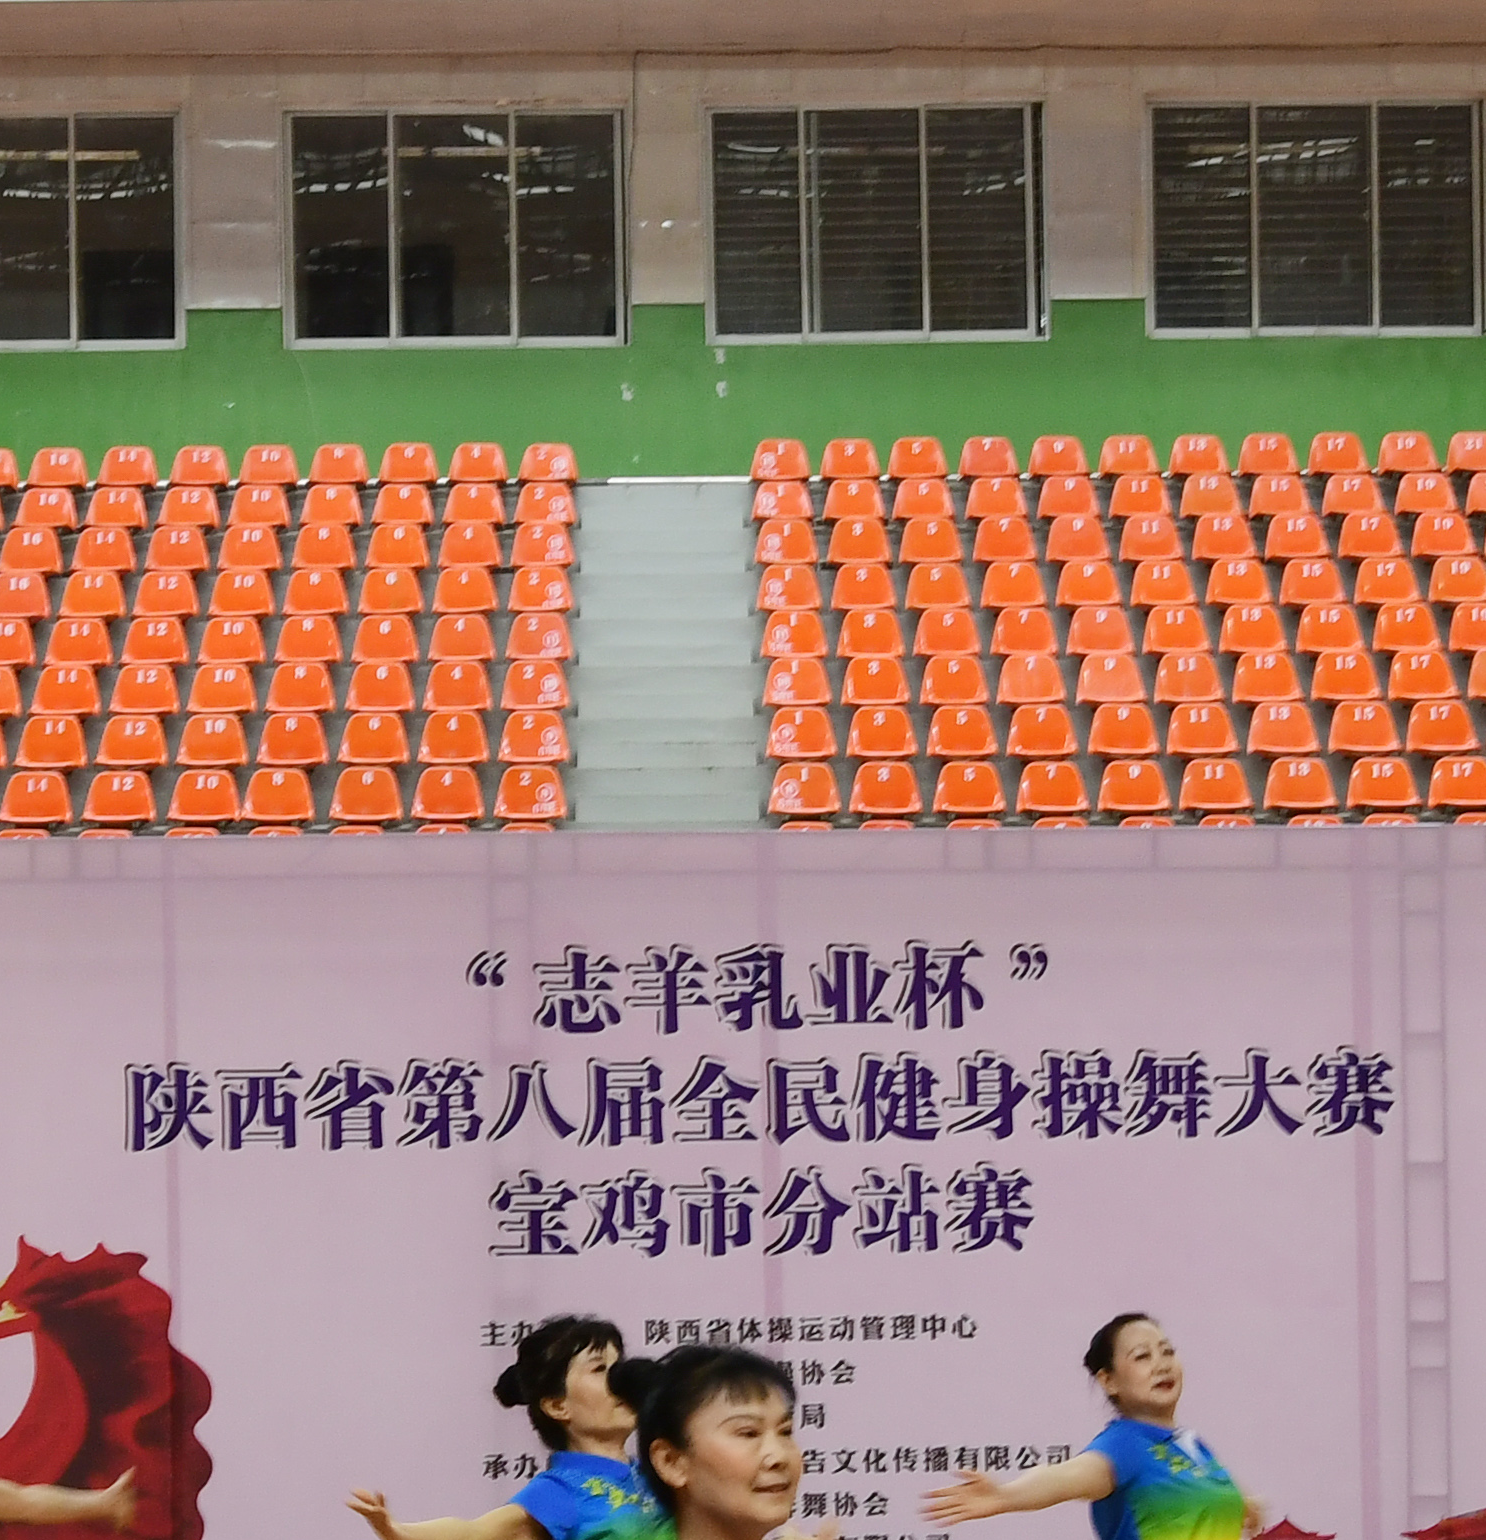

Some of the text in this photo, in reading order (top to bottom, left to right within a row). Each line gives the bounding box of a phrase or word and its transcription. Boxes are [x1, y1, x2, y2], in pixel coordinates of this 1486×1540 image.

[465, 941, 1050, 1033] “志羊乳业杯”
[123, 1045, 1395, 1152] 陕西省第八届全民健身操舞大赛
[487, 1163, 1036, 1260] 宝鸡市分站赛
[643, 1313, 978, 1346] 陕西省体操运动管理中心
[481, 1453, 540, 1480] 承办
[789, 1491, 890, 1519] 舞协会
